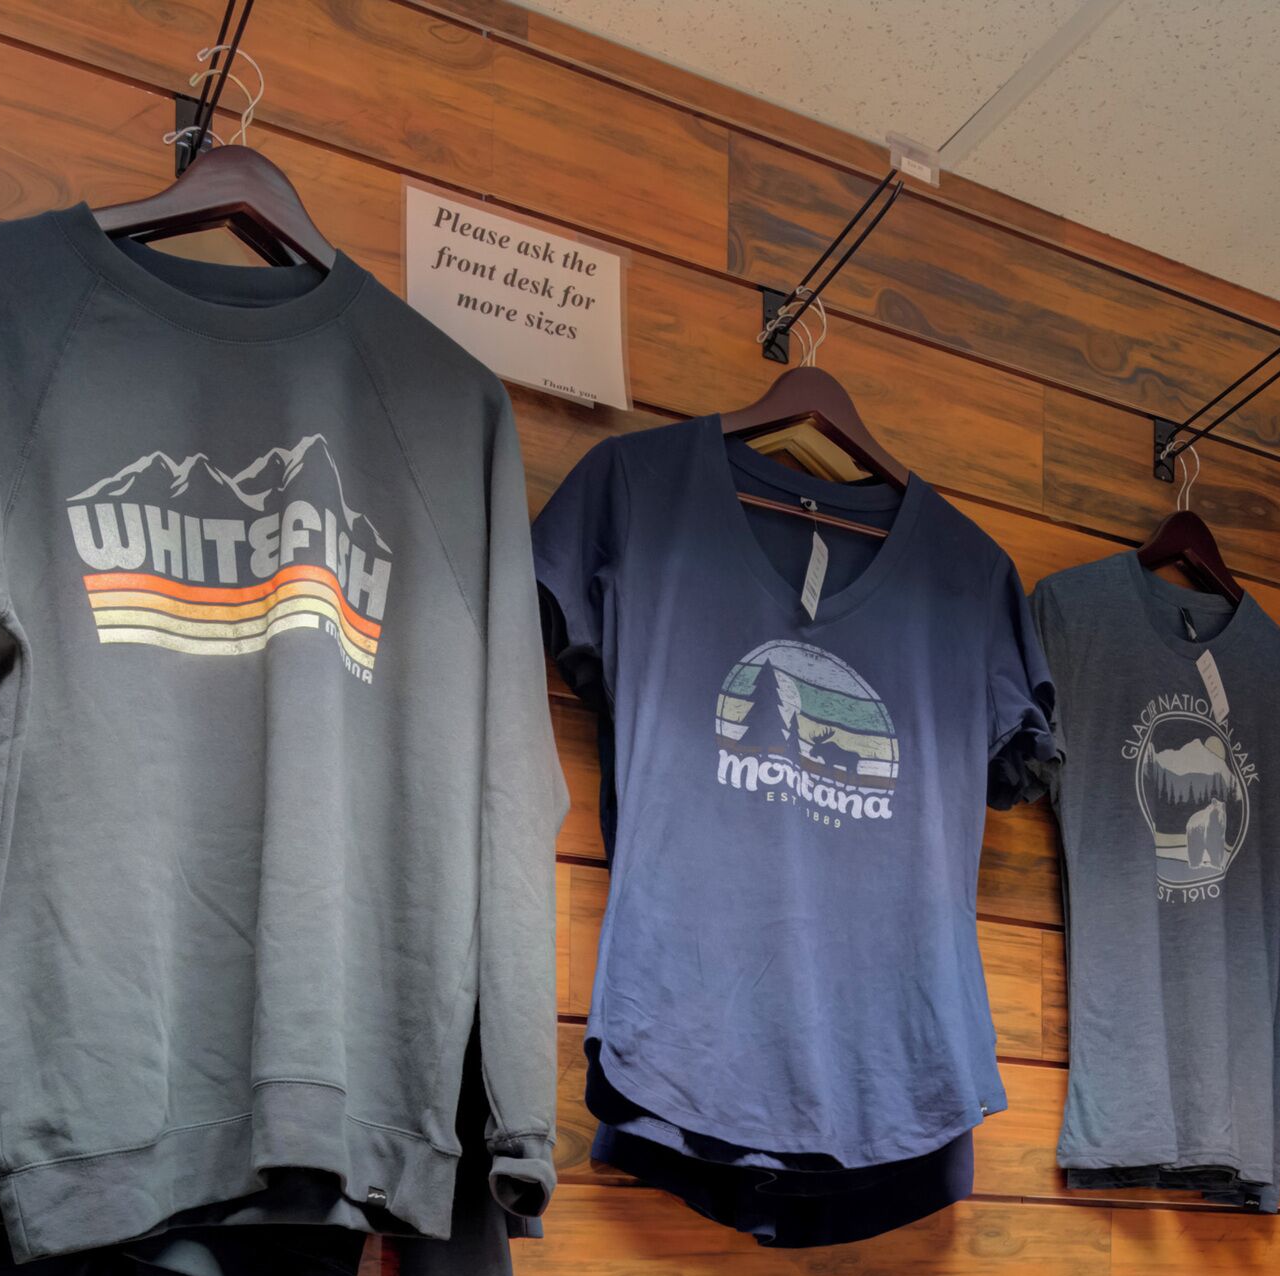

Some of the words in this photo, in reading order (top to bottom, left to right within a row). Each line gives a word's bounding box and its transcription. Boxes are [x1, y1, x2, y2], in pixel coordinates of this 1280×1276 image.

[433, 206, 511, 249] Please
[517, 241, 555, 265] ask
[562, 251, 598, 277] the
[431, 246, 497, 282] front
[503, 268, 554, 299] desk
[557, 285, 595, 311] for
[457, 292, 518, 323] more
[524, 311, 578, 341] sizes
[542, 378, 576, 395] Thank
[579, 387, 598, 401] you
[67, 500, 392, 622] WHITEFISH
[1230, 742, 1260, 787] PARK
[1156, 885, 1175, 904] ST.
[1182, 885, 1220, 903] 1910
